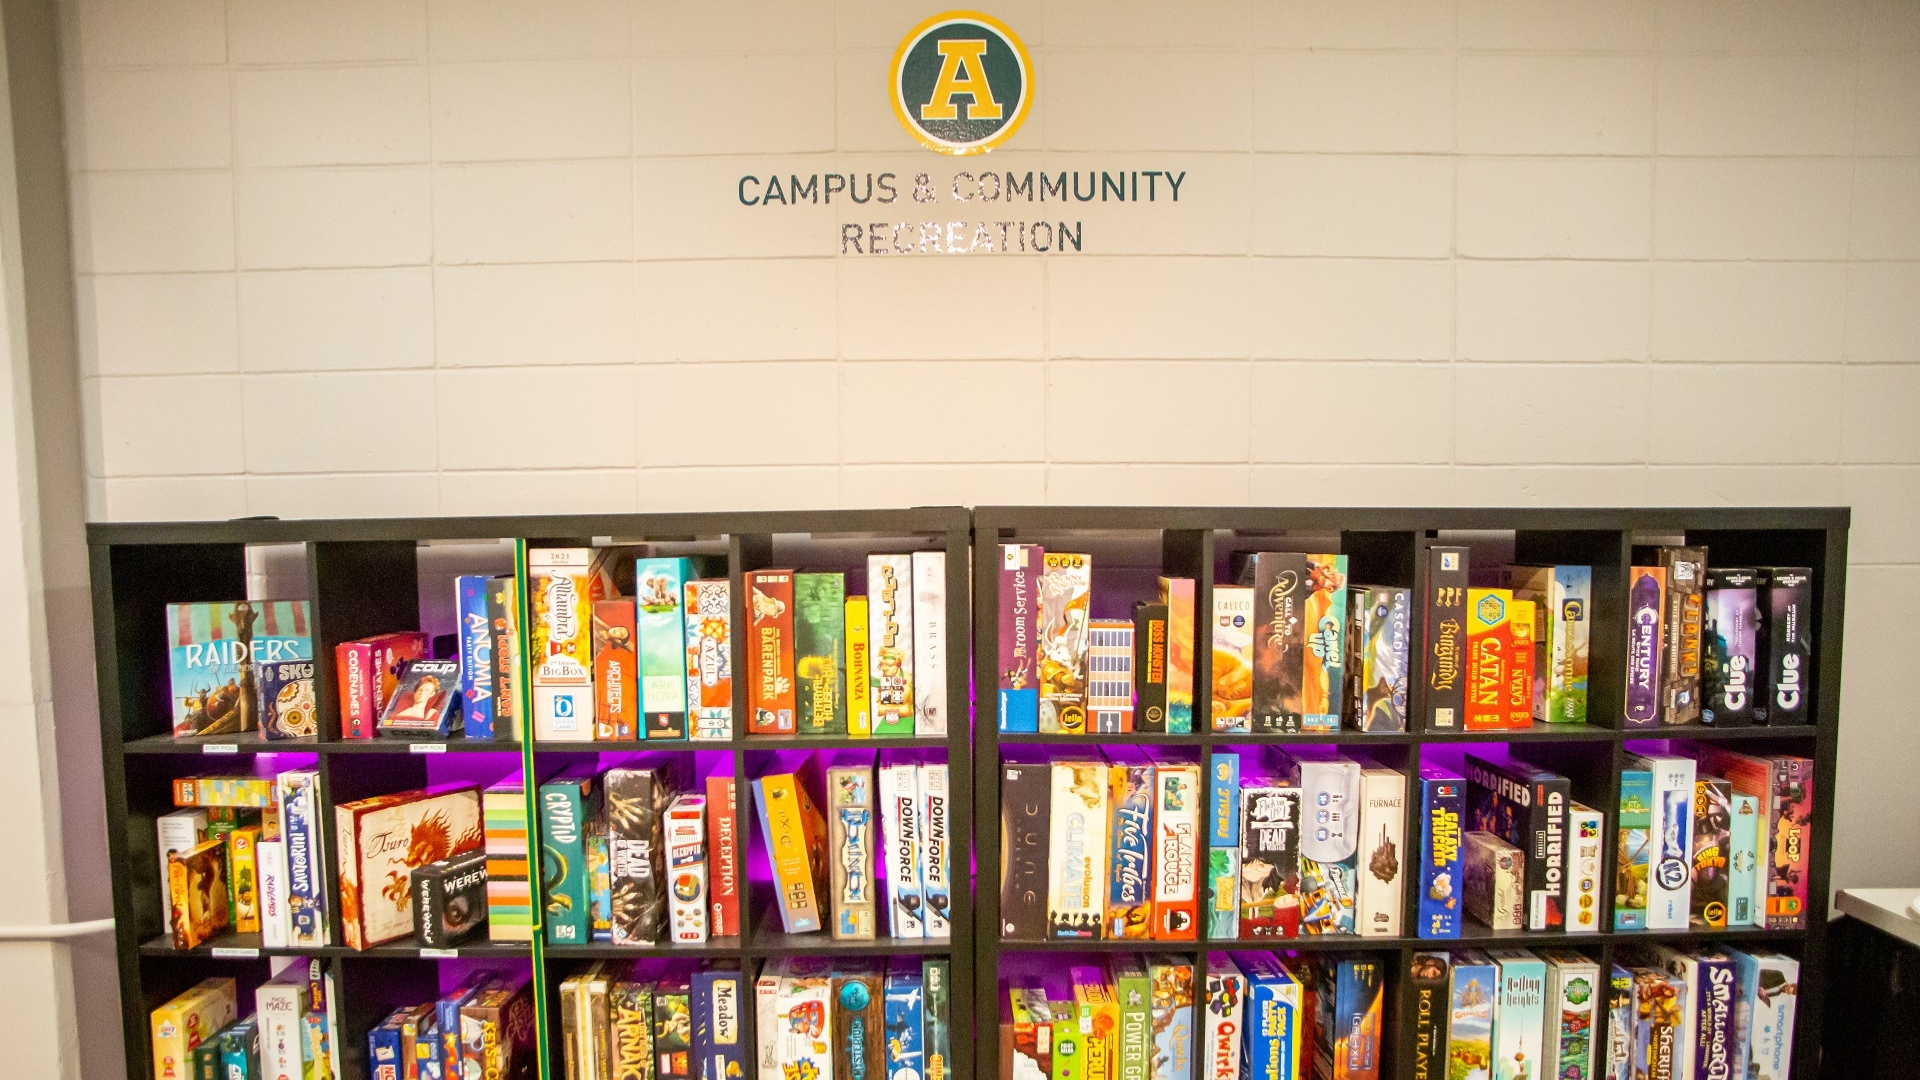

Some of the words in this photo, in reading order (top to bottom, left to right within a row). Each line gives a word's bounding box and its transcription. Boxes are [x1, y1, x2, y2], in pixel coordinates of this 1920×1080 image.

[921, 39, 1003, 120] A
[738, 172, 899, 206] CAMPUS
[912, 172, 937, 204] &
[952, 170, 1187, 204] COMMUNITY
[841, 221, 1083, 255] RECREATION
[1013, 571, 1028, 614] Service
[1218, 601, 1249, 610] CALICO
[928, 622, 936, 670] BRASS
[1013, 612, 1027, 658] Broom
[1152, 619, 1164, 643] BOSS
[1285, 624, 1291, 636] TO
[1393, 592, 1404, 666] CASCADIA
[1634, 603, 1658, 689] CENTURY
[186, 639, 300, 669] RAIDERS
[468, 612, 492, 703] ANOMIA
[705, 645, 717, 679] AZUL
[853, 642, 864, 701] BOHNANZA
[1151, 643, 1163, 684] MONSTER
[1432, 619, 1460, 690] Burgundy
[1478, 637, 1501, 706] CATAN
[348, 650, 361, 716] CODENAMES
[609, 660, 622, 714] ARCHITECTS
[647, 691, 680, 701] NOVA
[812, 677, 825, 728] BETRAYAL
[1510, 669, 1523, 705] CATAN
[1724, 655, 1746, 710] Clue
[1777, 653, 1800, 709] Clue
[544, 792, 578, 844] CRYPTID
[1370, 799, 1402, 808] FURNACE
[367, 831, 409, 859] Tsuro
[616, 839, 627, 850] OF
[627, 839, 650, 878] DEAD
[718, 817, 734, 896] DECEPTION
[1024, 804, 1038, 903] DUNE
[1177, 823, 1191, 885] FLAMME
[1260, 829, 1286, 843] DEAD
[1432, 807, 1446, 867] TRUCKER
[1445, 812, 1458, 862] GALAXY
[1545, 791, 1562, 896] HORRIFIED
[1697, 846, 1719, 862] KING
[1787, 829, 1801, 862] LOOP
[616, 850, 627, 878] WINTER
[1065, 812, 1085, 909] CLIMATE
[1164, 840, 1178, 895] ROUGE
[1663, 861, 1682, 885] K2
[1695, 857, 1727, 871] TOKYO
[267, 874, 277, 917] RADLANDS
[420, 879, 434, 944] WEREWOLF
[266, 1002, 293, 1011] MAZE
[717, 987, 733, 1039] Meadow
[1268, 1000, 1278, 1036] PARTY
[1277, 1006, 1287, 1036] PACK
[1418, 989, 1431, 1029] ROLL
[483, 1021, 497, 1057] KEYS
[616, 1004, 641, 1080] ARNAK
[852, 1020, 863, 1077] MYSTERIUM
[1126, 1012, 1145, 1063] POWER
[1773, 1003, 1785, 1070] smartphone
